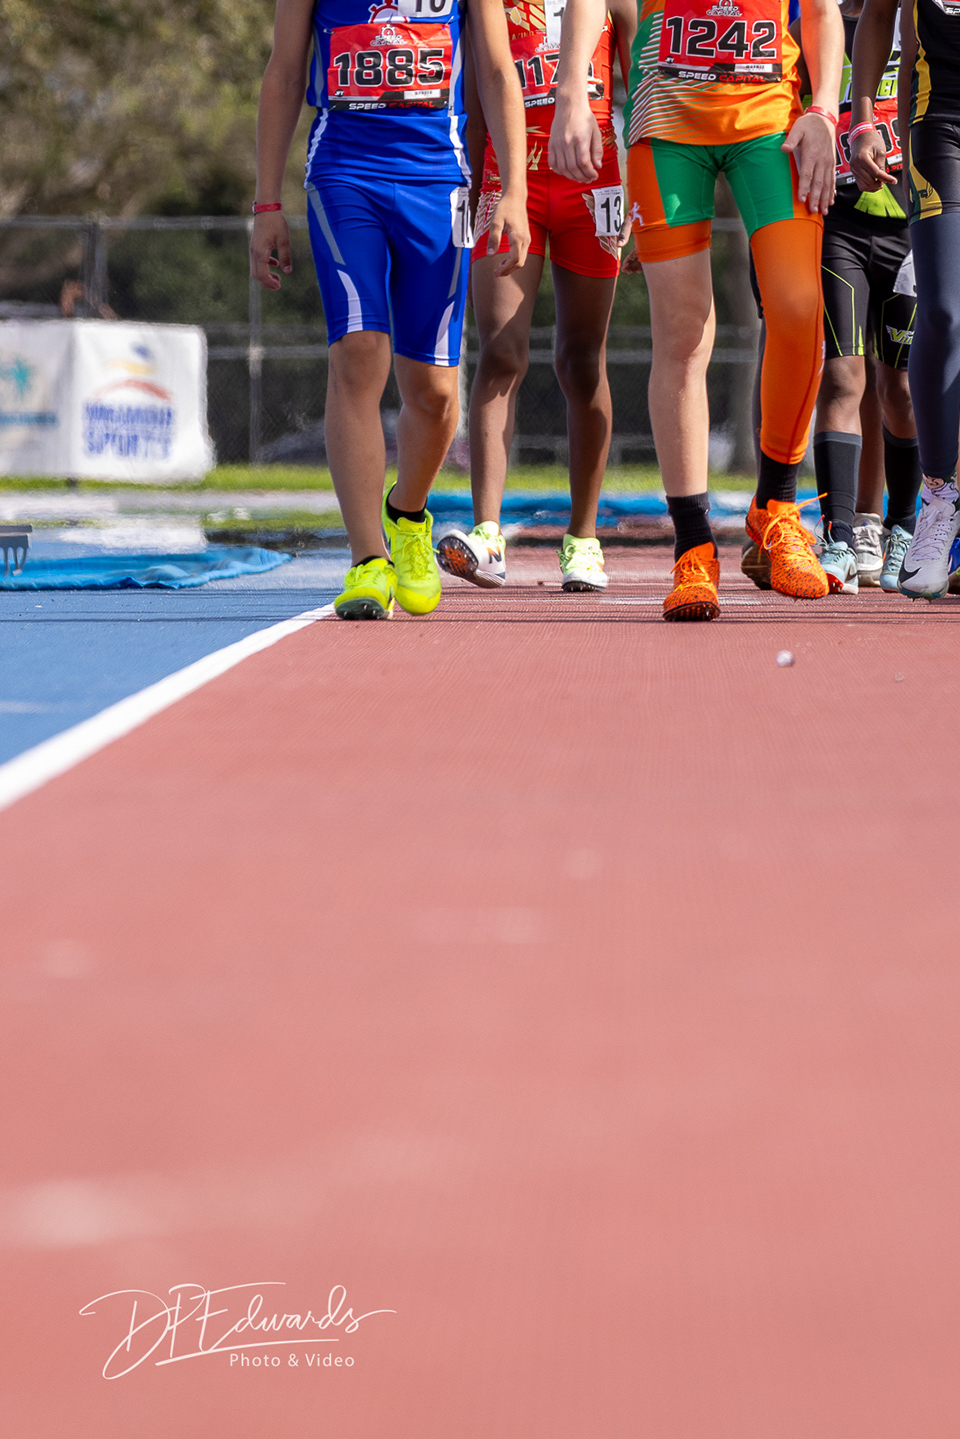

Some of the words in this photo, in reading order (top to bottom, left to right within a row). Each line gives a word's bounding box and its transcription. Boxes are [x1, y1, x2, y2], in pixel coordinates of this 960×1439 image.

[666, 16, 777, 59] 1242
[333, 48, 445, 87] 1885
[678, 71, 717, 81] SPEED
[718, 74, 767, 83] CAPITAL
[348, 102, 387, 110] SPEED
[600, 195, 622, 233] 13
